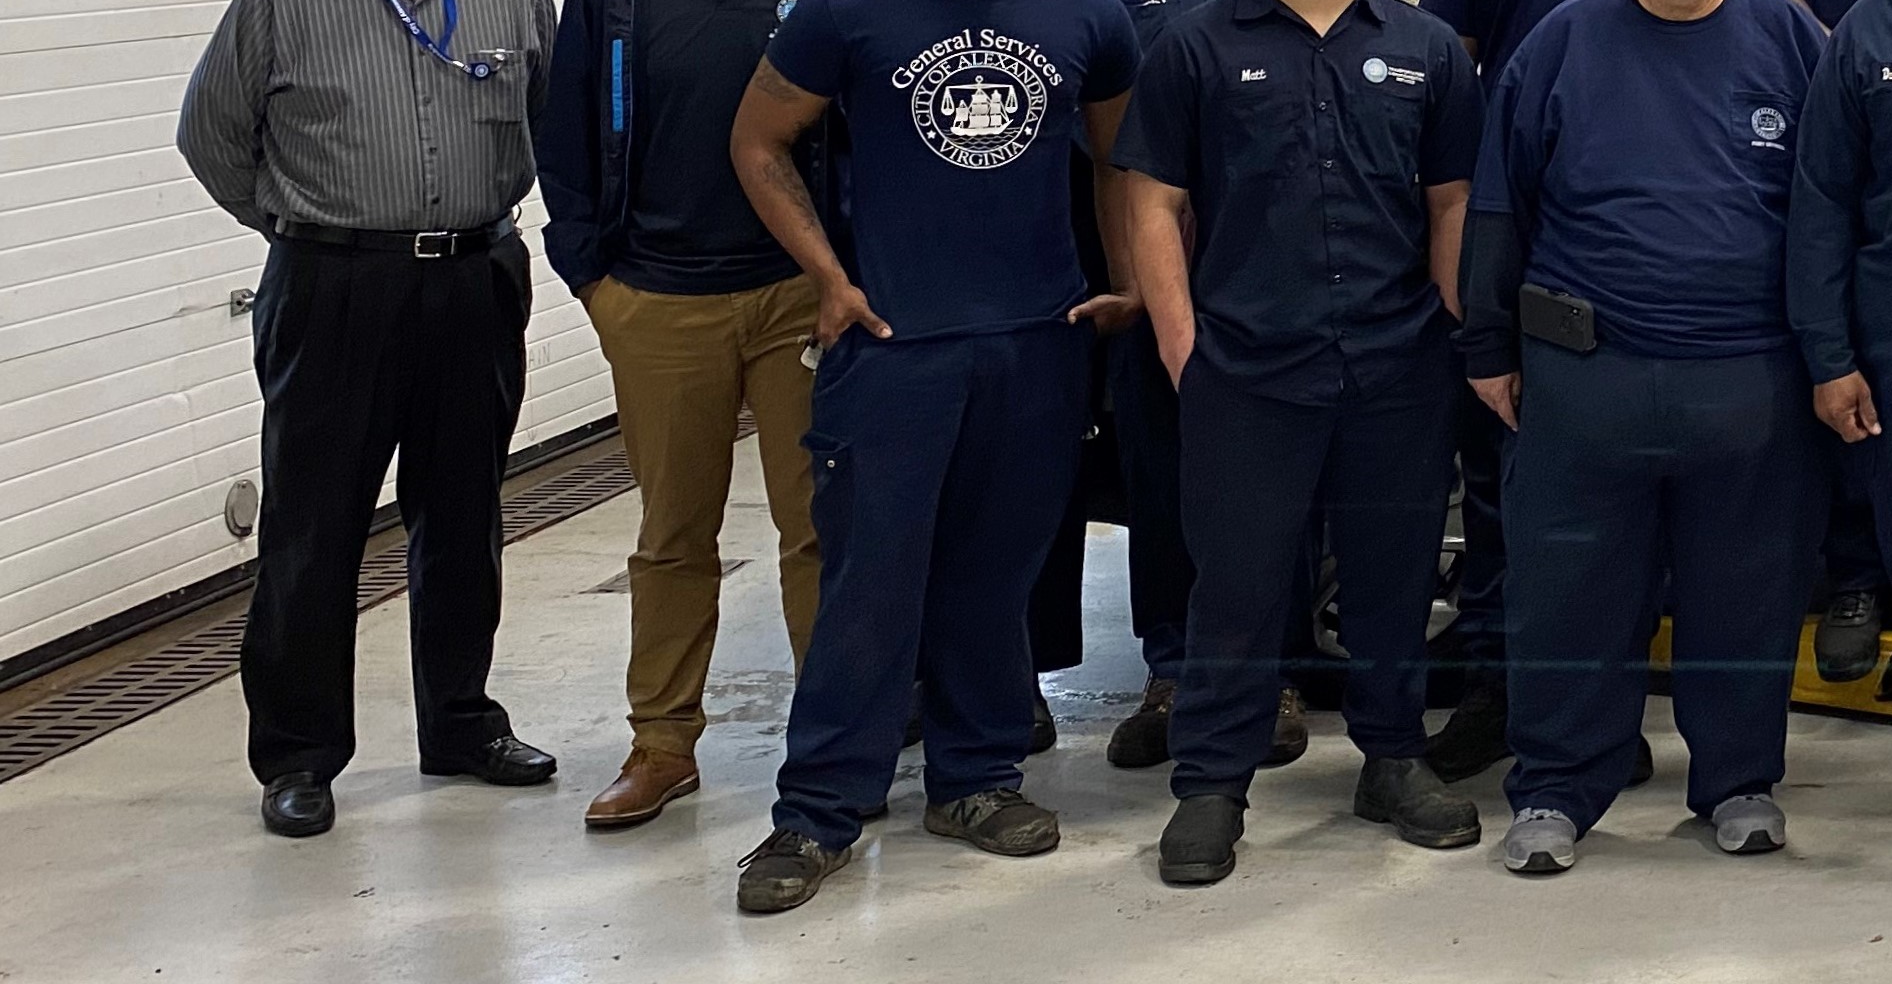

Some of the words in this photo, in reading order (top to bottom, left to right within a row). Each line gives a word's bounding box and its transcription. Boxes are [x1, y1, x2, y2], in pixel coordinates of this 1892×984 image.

[891, 29, 973, 89] General
[980, 29, 1063, 87] Services
[1241, 68, 1267, 82] Matt
[915, 88, 935, 127] CITY
[928, 61, 952, 85] OF
[957, 53, 1045, 124] ALEXANDRIA
[938, 139, 1024, 167] VIRGINIA
